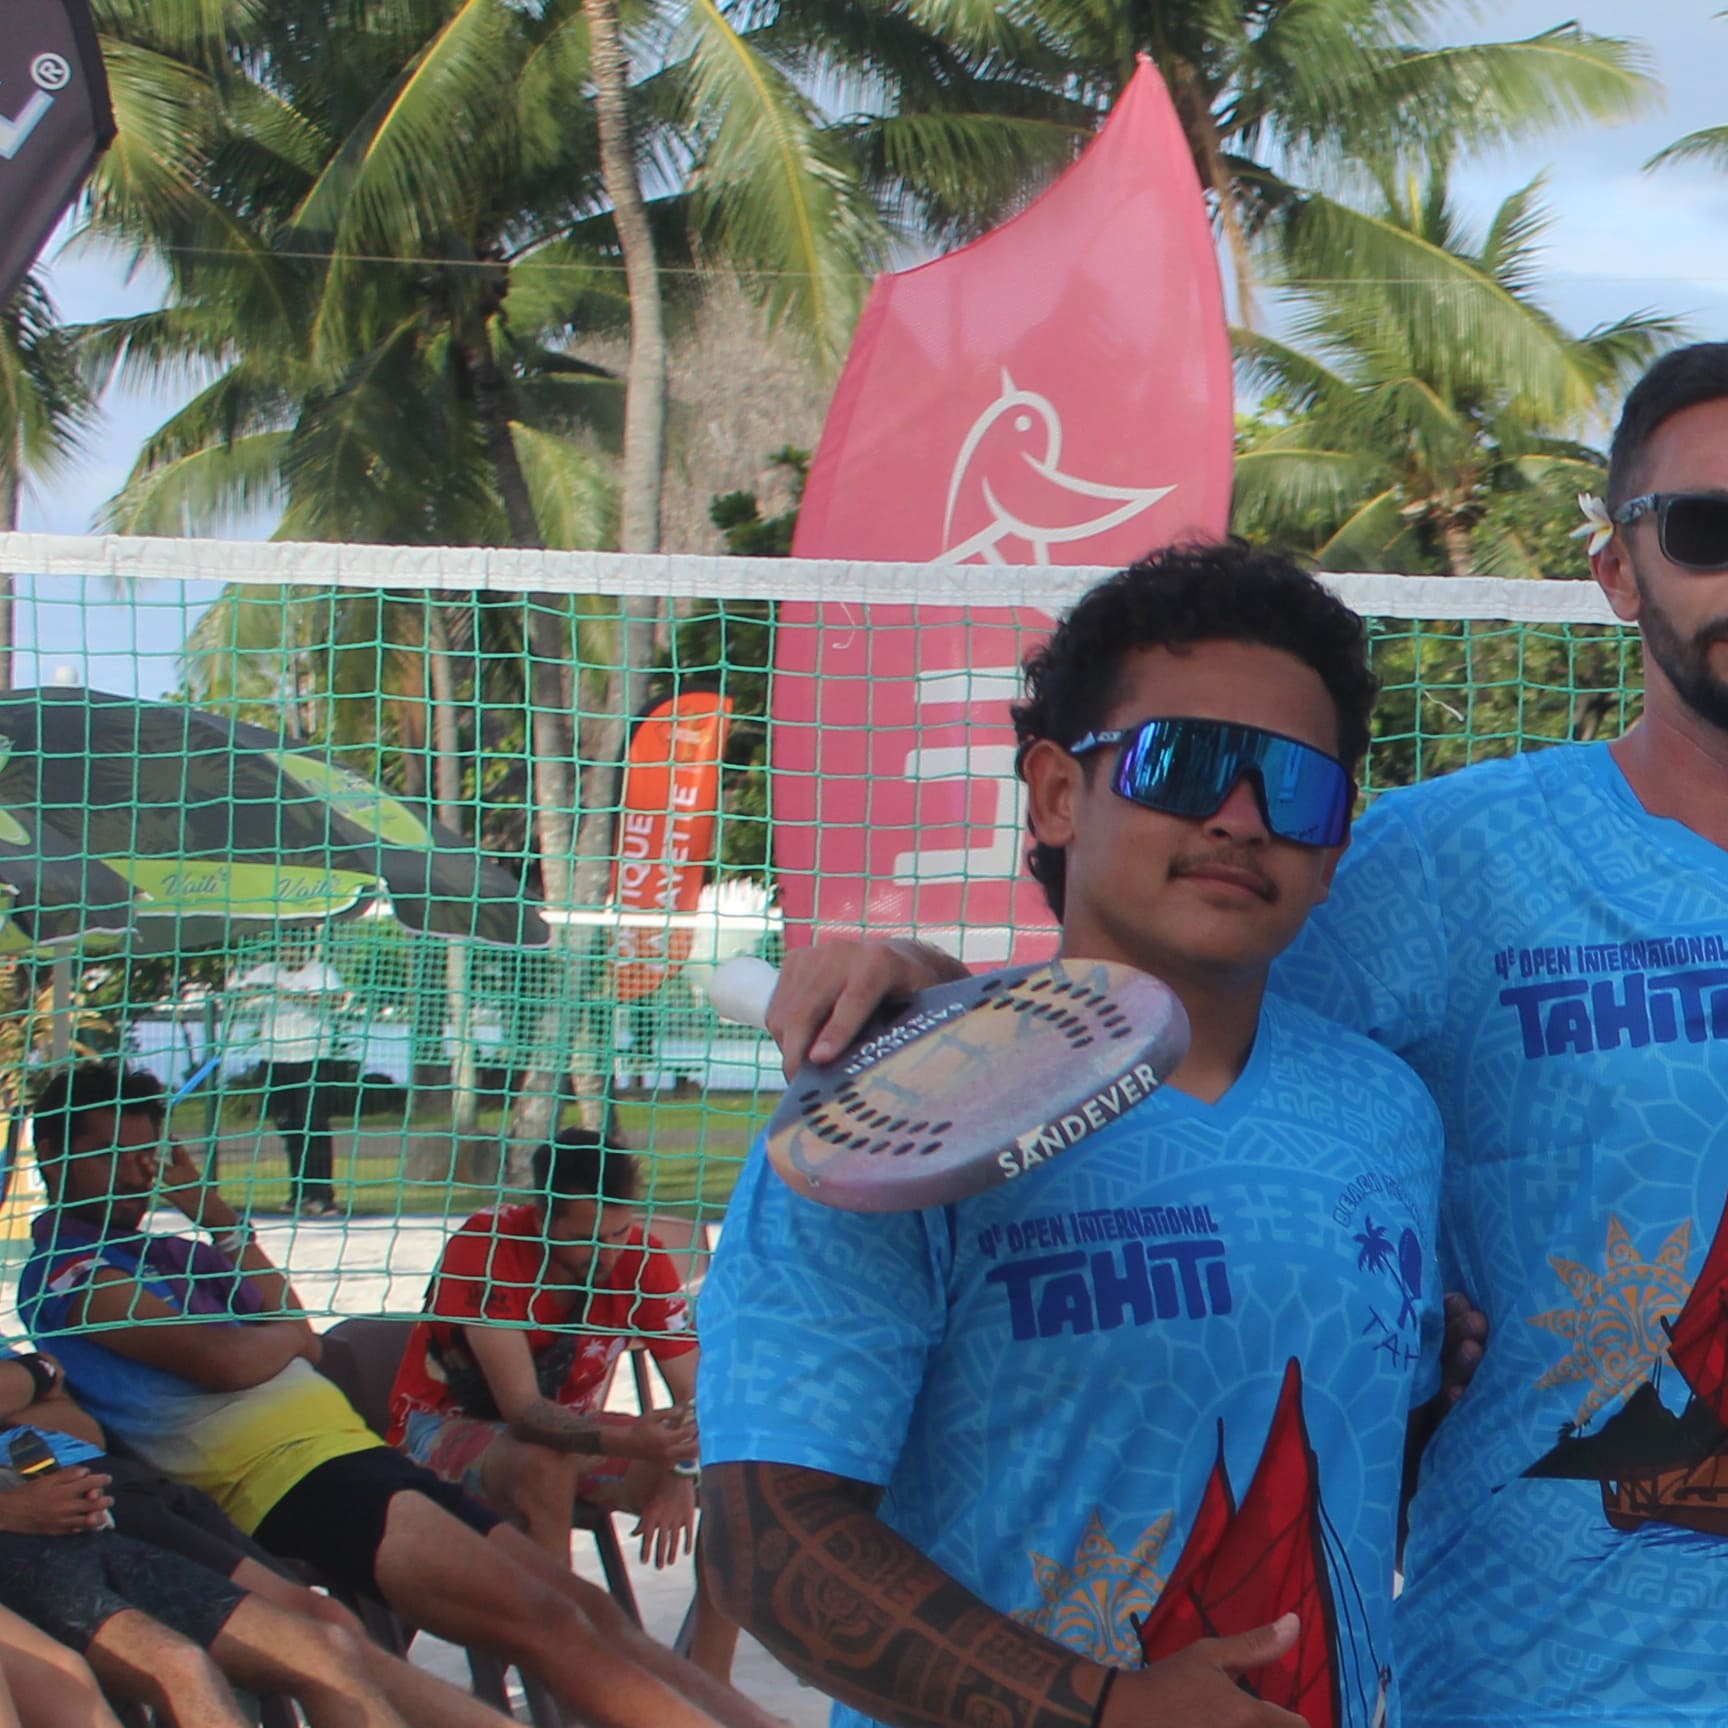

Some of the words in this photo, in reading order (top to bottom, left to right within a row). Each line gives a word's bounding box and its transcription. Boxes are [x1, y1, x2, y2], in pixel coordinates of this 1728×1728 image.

[1519, 947, 1572, 978] OPEN
[997, 1063, 1159, 1180] SANDEVER
[1008, 1216, 1067, 1255] OPEN
[1072, 1204, 1219, 1245] INTERNATIONAL
[986, 1239, 1232, 1341] TAHITI
